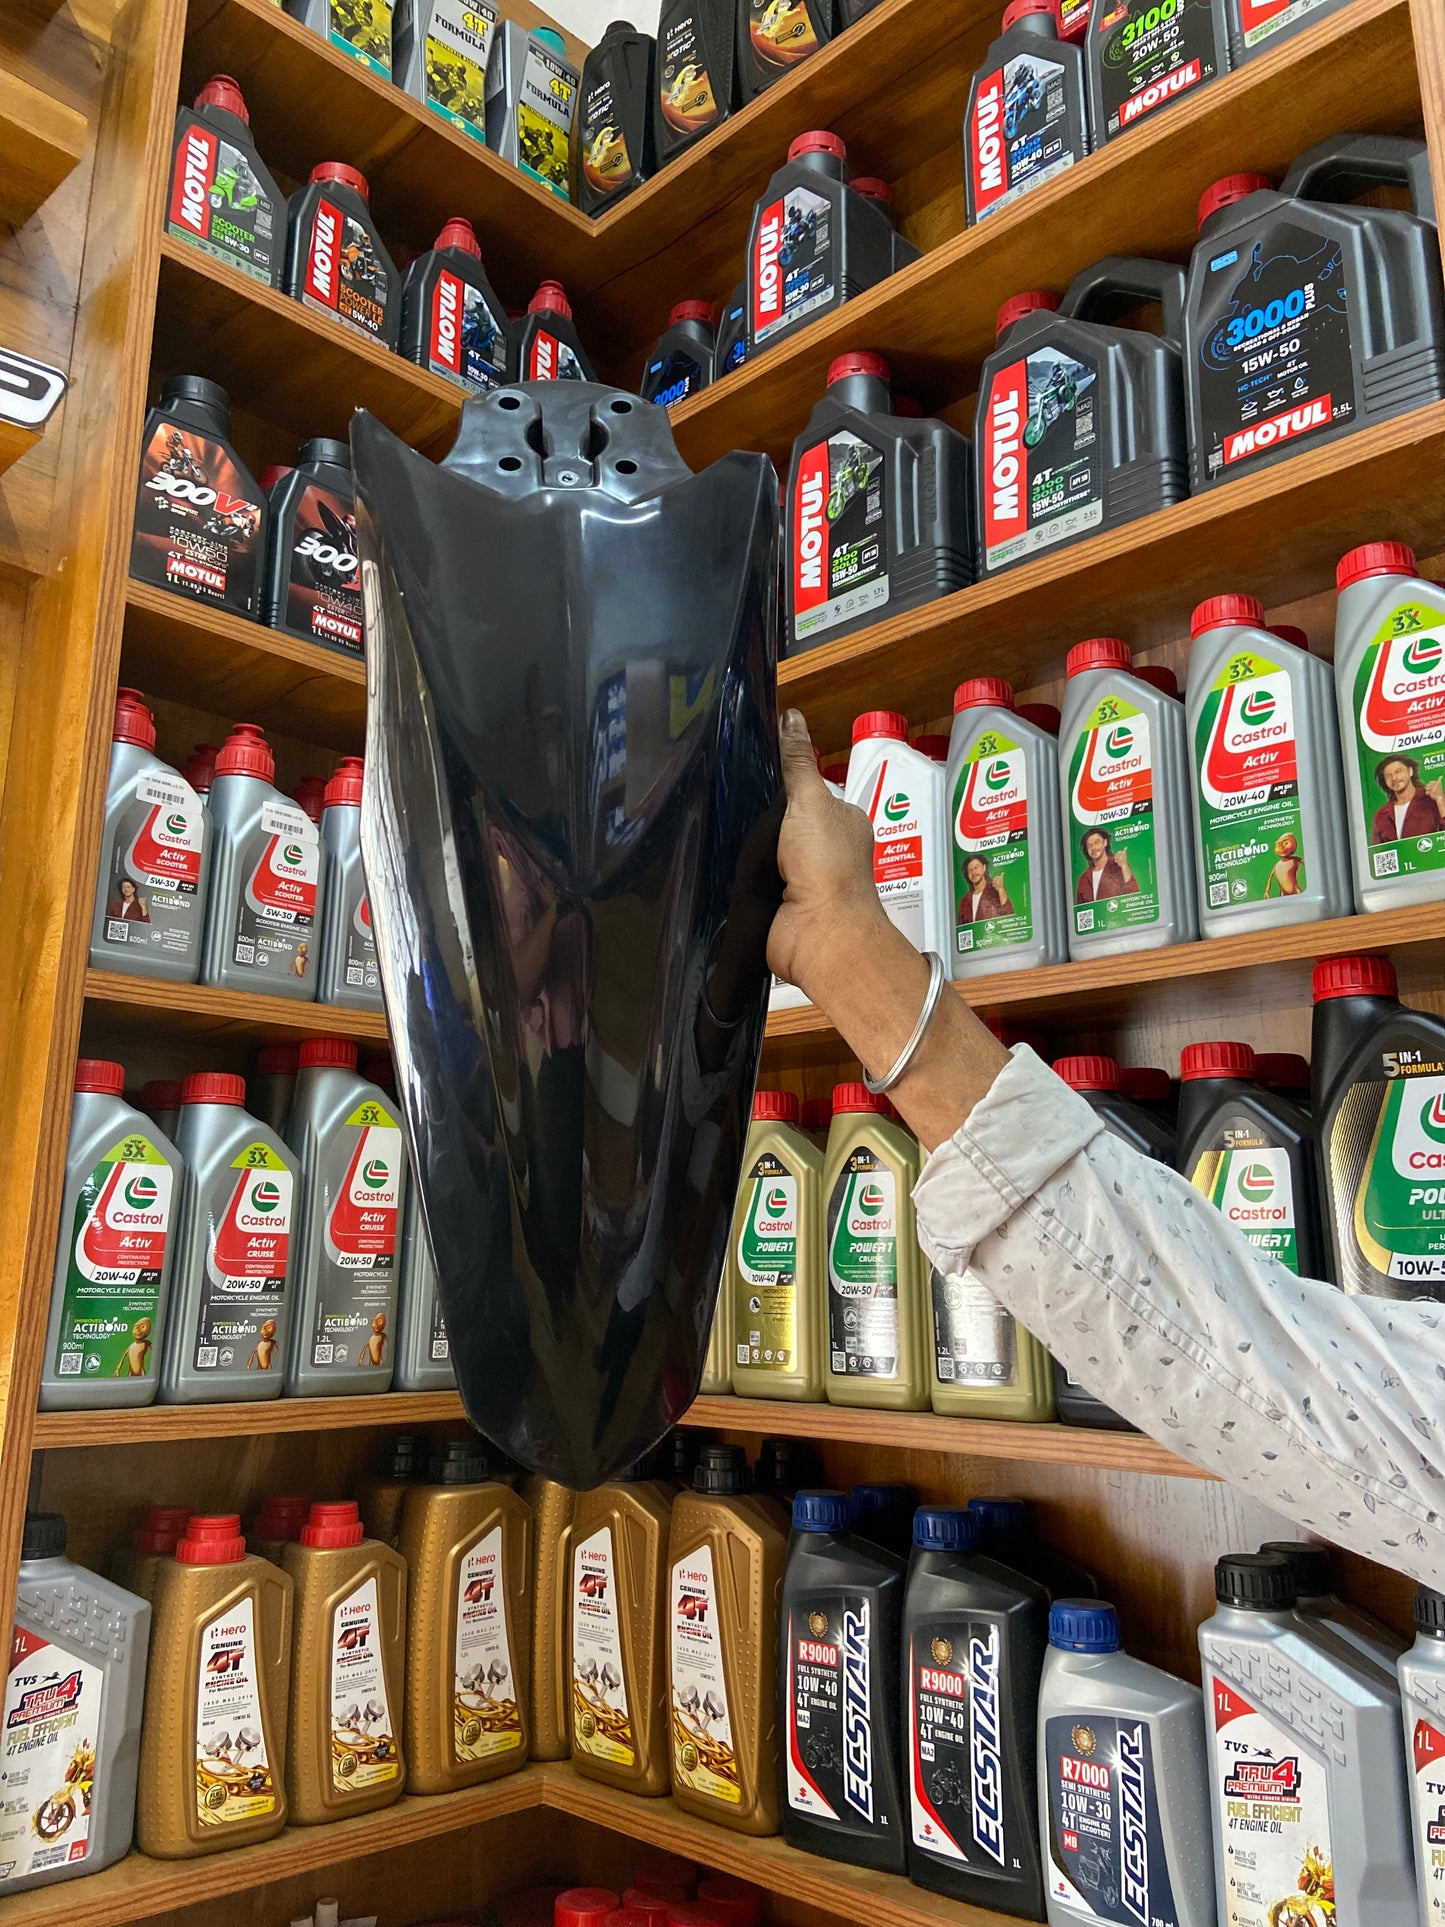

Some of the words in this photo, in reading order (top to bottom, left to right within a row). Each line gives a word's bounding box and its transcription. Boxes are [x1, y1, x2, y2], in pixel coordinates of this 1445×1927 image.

[1064, 4, 1089, 24] MOTUL
[462, 12, 488, 37] 4T
[1121, 0, 1176, 46] 3100
[436, 13, 486, 53] FORMULA
[1132, 26, 1179, 62] 20W-50
[549, 78, 571, 101] 4T
[1124, 64, 1197, 121] MOTUL
[1203, 64, 1213, 73] 1L
[526, 80, 570, 118] FORMULA
[977, 86, 1002, 191] MOTUL
[1010, 134, 1027, 152] 4T
[181, 135, 209, 231] MOTUL
[213, 214, 255, 243] SCOOTER
[225, 235, 250, 254] 5W-30
[313, 209, 335, 298] MOTUL
[760, 217, 779, 313] MOTUL
[785, 268, 799, 282] 4T
[340, 282, 384, 317] SCOOTER
[1226, 289, 1305, 346] 3000
[1304, 282, 1315, 310] PLUS
[438, 280, 457, 365] MOTUL
[468, 349, 480, 360] 4T
[1241, 338, 1300, 374] 15W-50
[1287, 360, 1296, 368] 4T
[1277, 366, 1298, 379] MOTOR
[1229, 400, 1327, 459] MOTUL
[1332, 402, 1352, 417] 2.5L
[993, 390, 1019, 521] MOTUL
[1032, 467, 1053, 485] 4T
[1032, 490, 1064, 512] 15W-50
[801, 471, 823, 588] MOTUL
[170, 535, 228, 562] 10W50
[832, 542, 850, 558] 4T
[170, 561, 223, 588] MOTUL
[315, 614, 359, 640] MOTUL
[1392, 610, 1421, 633] 3X
[1230, 660, 1254, 679] 3X
[1407, 696, 1444, 714] Activ
[1232, 722, 1287, 747] Castrol
[1397, 730, 1442, 748] 20W-40
[1098, 756, 1142, 776] Castrol
[1242, 751, 1279, 769] Activ
[1107, 778, 1133, 792] Activ
[978, 788, 1018, 806] Castrol
[1223, 790, 1265, 808] 20W-40
[986, 808, 1009, 821] Activ
[1099, 807, 1129, 821] 10W-30
[1210, 809, 1252, 824] MOTORCYCLE
[1254, 803, 1279, 815] ENGINE
[877, 819, 917, 837] Castrol
[158, 832, 191, 846] Castrol
[979, 836, 1006, 848] 10W-30
[160, 849, 186, 862] Activ
[884, 843, 910, 856] Activ
[156, 858, 188, 870] SCOOTER
[878, 853, 916, 864] ESSENTIAL
[1404, 862, 1416, 870] 1L
[276, 863, 306, 877] Castrol
[1208, 871, 1227, 882] 900ml
[149, 876, 175, 889] 5W-30
[278, 881, 302, 894] Activ
[274, 890, 304, 902] SCOOTER
[265, 908, 292, 921] 5W-30
[256, 918, 280, 928] SCOOTER
[281, 922, 300, 932] ENGINE
[301, 926, 309, 934] OIL
[129, 935, 148, 945] 600ml
[238, 935, 256, 944] 600ml
[1382, 1052, 1400, 1077] 5
[1400, 1050, 1422, 1062] IN-1
[1400, 1062, 1443, 1075] FORMULA
[361, 1109, 380, 1122] 3X
[122, 1143, 146, 1158] 3X
[248, 1151, 268, 1164] 3X
[354, 1191, 394, 1202] Castrol
[113, 1212, 163, 1225] Castrol
[360, 1212, 386, 1222] Activ
[1229, 1206, 1286, 1220] Castrol
[241, 1215, 285, 1227] Castrol
[759, 1220, 792, 1232] Castrol
[851, 1219, 891, 1231] Castrol
[119, 1237, 152, 1248] Activ
[247, 1238, 277, 1249] Activ
[756, 1242, 794, 1252] POWER1
[849, 1242, 892, 1253] POWER1
[247, 1250, 275, 1258] CRUISE
[339, 1256, 372, 1265] 20W-50
[859, 1255, 884, 1263] CRUISE
[226, 1279, 261, 1289] 20W-50
[752, 1274, 775, 1283] 10W-40
[841, 1285, 872, 1296] 20W-50
[62, 1342, 84, 1350] 900ml
[476, 1554, 495, 1565] Hero
[589, 1551, 607, 1562] Hero
[468, 1569, 493, 1579] GENUINE
[582, 1565, 605, 1574] GENUINE
[687, 1571, 708, 1582] Hero
[680, 1585, 706, 1595] GENUINE
[349, 1604, 371, 1615] Hero
[221, 1624, 246, 1636] Hero
[341, 1618, 368, 1627] GENUINE
[14, 1638, 28, 1652] 1L
[210, 1640, 243, 1649] GENUINE
[337, 1626, 370, 1650] 4T
[799, 1641, 837, 1665] R9000
[206, 1650, 245, 1674] 4T
[798, 1665, 810, 1673] FULL
[811, 1666, 838, 1679] SYNTHETIC
[14, 1675, 38, 1687] TVS
[797, 1675, 837, 1696] 10W-40
[921, 1669, 962, 1695] R9000
[797, 1692, 809, 1709] 4T
[811, 1698, 828, 1708] ENGINE
[829, 1701, 837, 1710] OIL
[920, 1694, 933, 1703] FULL
[934, 1696, 964, 1710] SYNTHETIC
[1217, 1694, 1232, 1712] 1L
[843, 1597, 873, 1824] ECSTAR
[920, 1705, 964, 1730] 10W-40
[920, 1724, 932, 1741] 4T
[935, 1729, 954, 1741] ENGINE
[955, 1733, 964, 1744] OIL
[1417, 1731, 1434, 1751] 1L
[7, 1744, 17, 1756] 4T
[17, 1736, 46, 1754] ENGINE
[47, 1732, 59, 1744] OIL
[969, 1623, 1005, 1867] ECSTAR
[1224, 1741, 1249, 1754] TVS
[1062, 1757, 1109, 1788] R7000
[1061, 1780, 1076, 1790] SEMI
[1077, 1786, 1110, 1800] SYNTHETIC
[1226, 1781, 1283, 1793] PREMIUM
[794, 1796, 813, 1806] SUZUKI
[1061, 1792, 1111, 1821] 10W-30
[1227, 1802, 1250, 1817] FUEL
[1252, 1804, 1302, 1822] EFFICIENT
[1062, 1811, 1076, 1829] 4T
[1079, 1816, 1100, 1827] ENGINE
[1101, 1822, 1111, 1831] OIL
[1117, 1724, 1149, 1927] ECSTAR
[1228, 1819, 1238, 1830] 4T
[1239, 1820, 1268, 1833] ENGINE
[1270, 1821, 1283, 1834] OIL
[919, 1833, 938, 1844] SUZUKI
